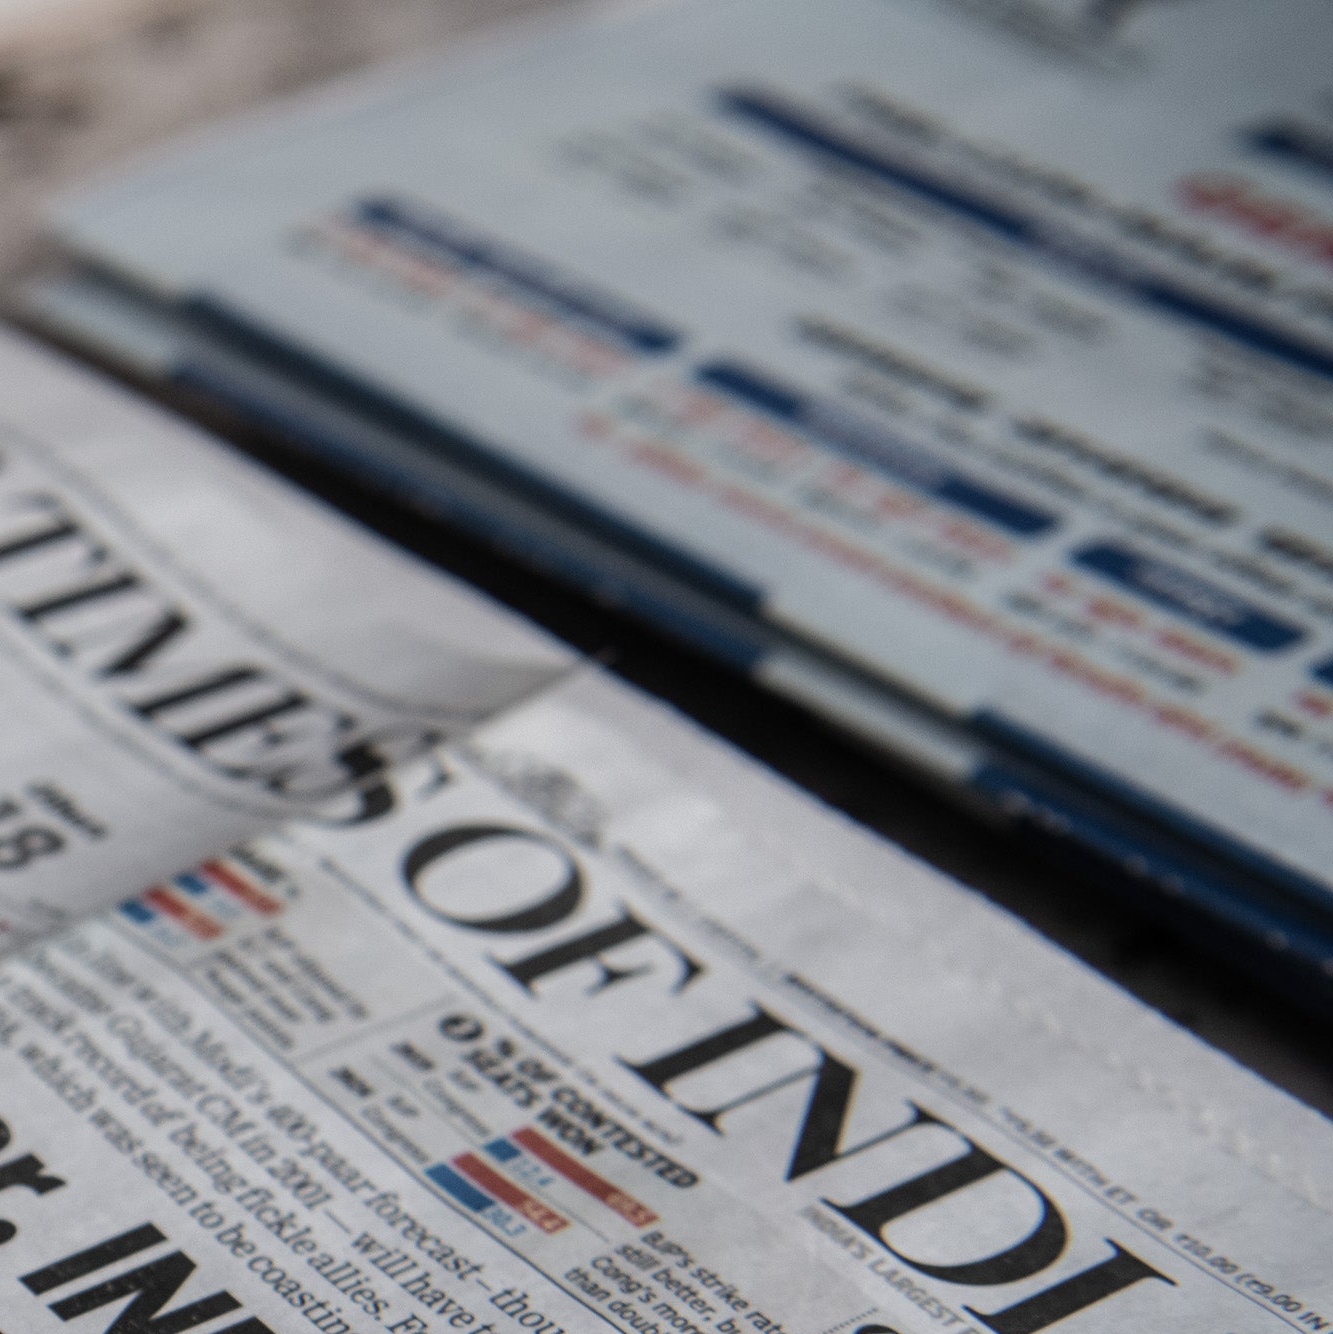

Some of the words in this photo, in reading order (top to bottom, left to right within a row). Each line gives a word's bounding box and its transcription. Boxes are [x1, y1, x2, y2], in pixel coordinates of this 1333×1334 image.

[399, 820, 704, 996] OF
[350, 1231, 419, 1280] will
[399, 1271, 475, 1328] have
[800, 1205, 874, 1261] INDIA'S
[867, 1258, 966, 1327] LARGEST
